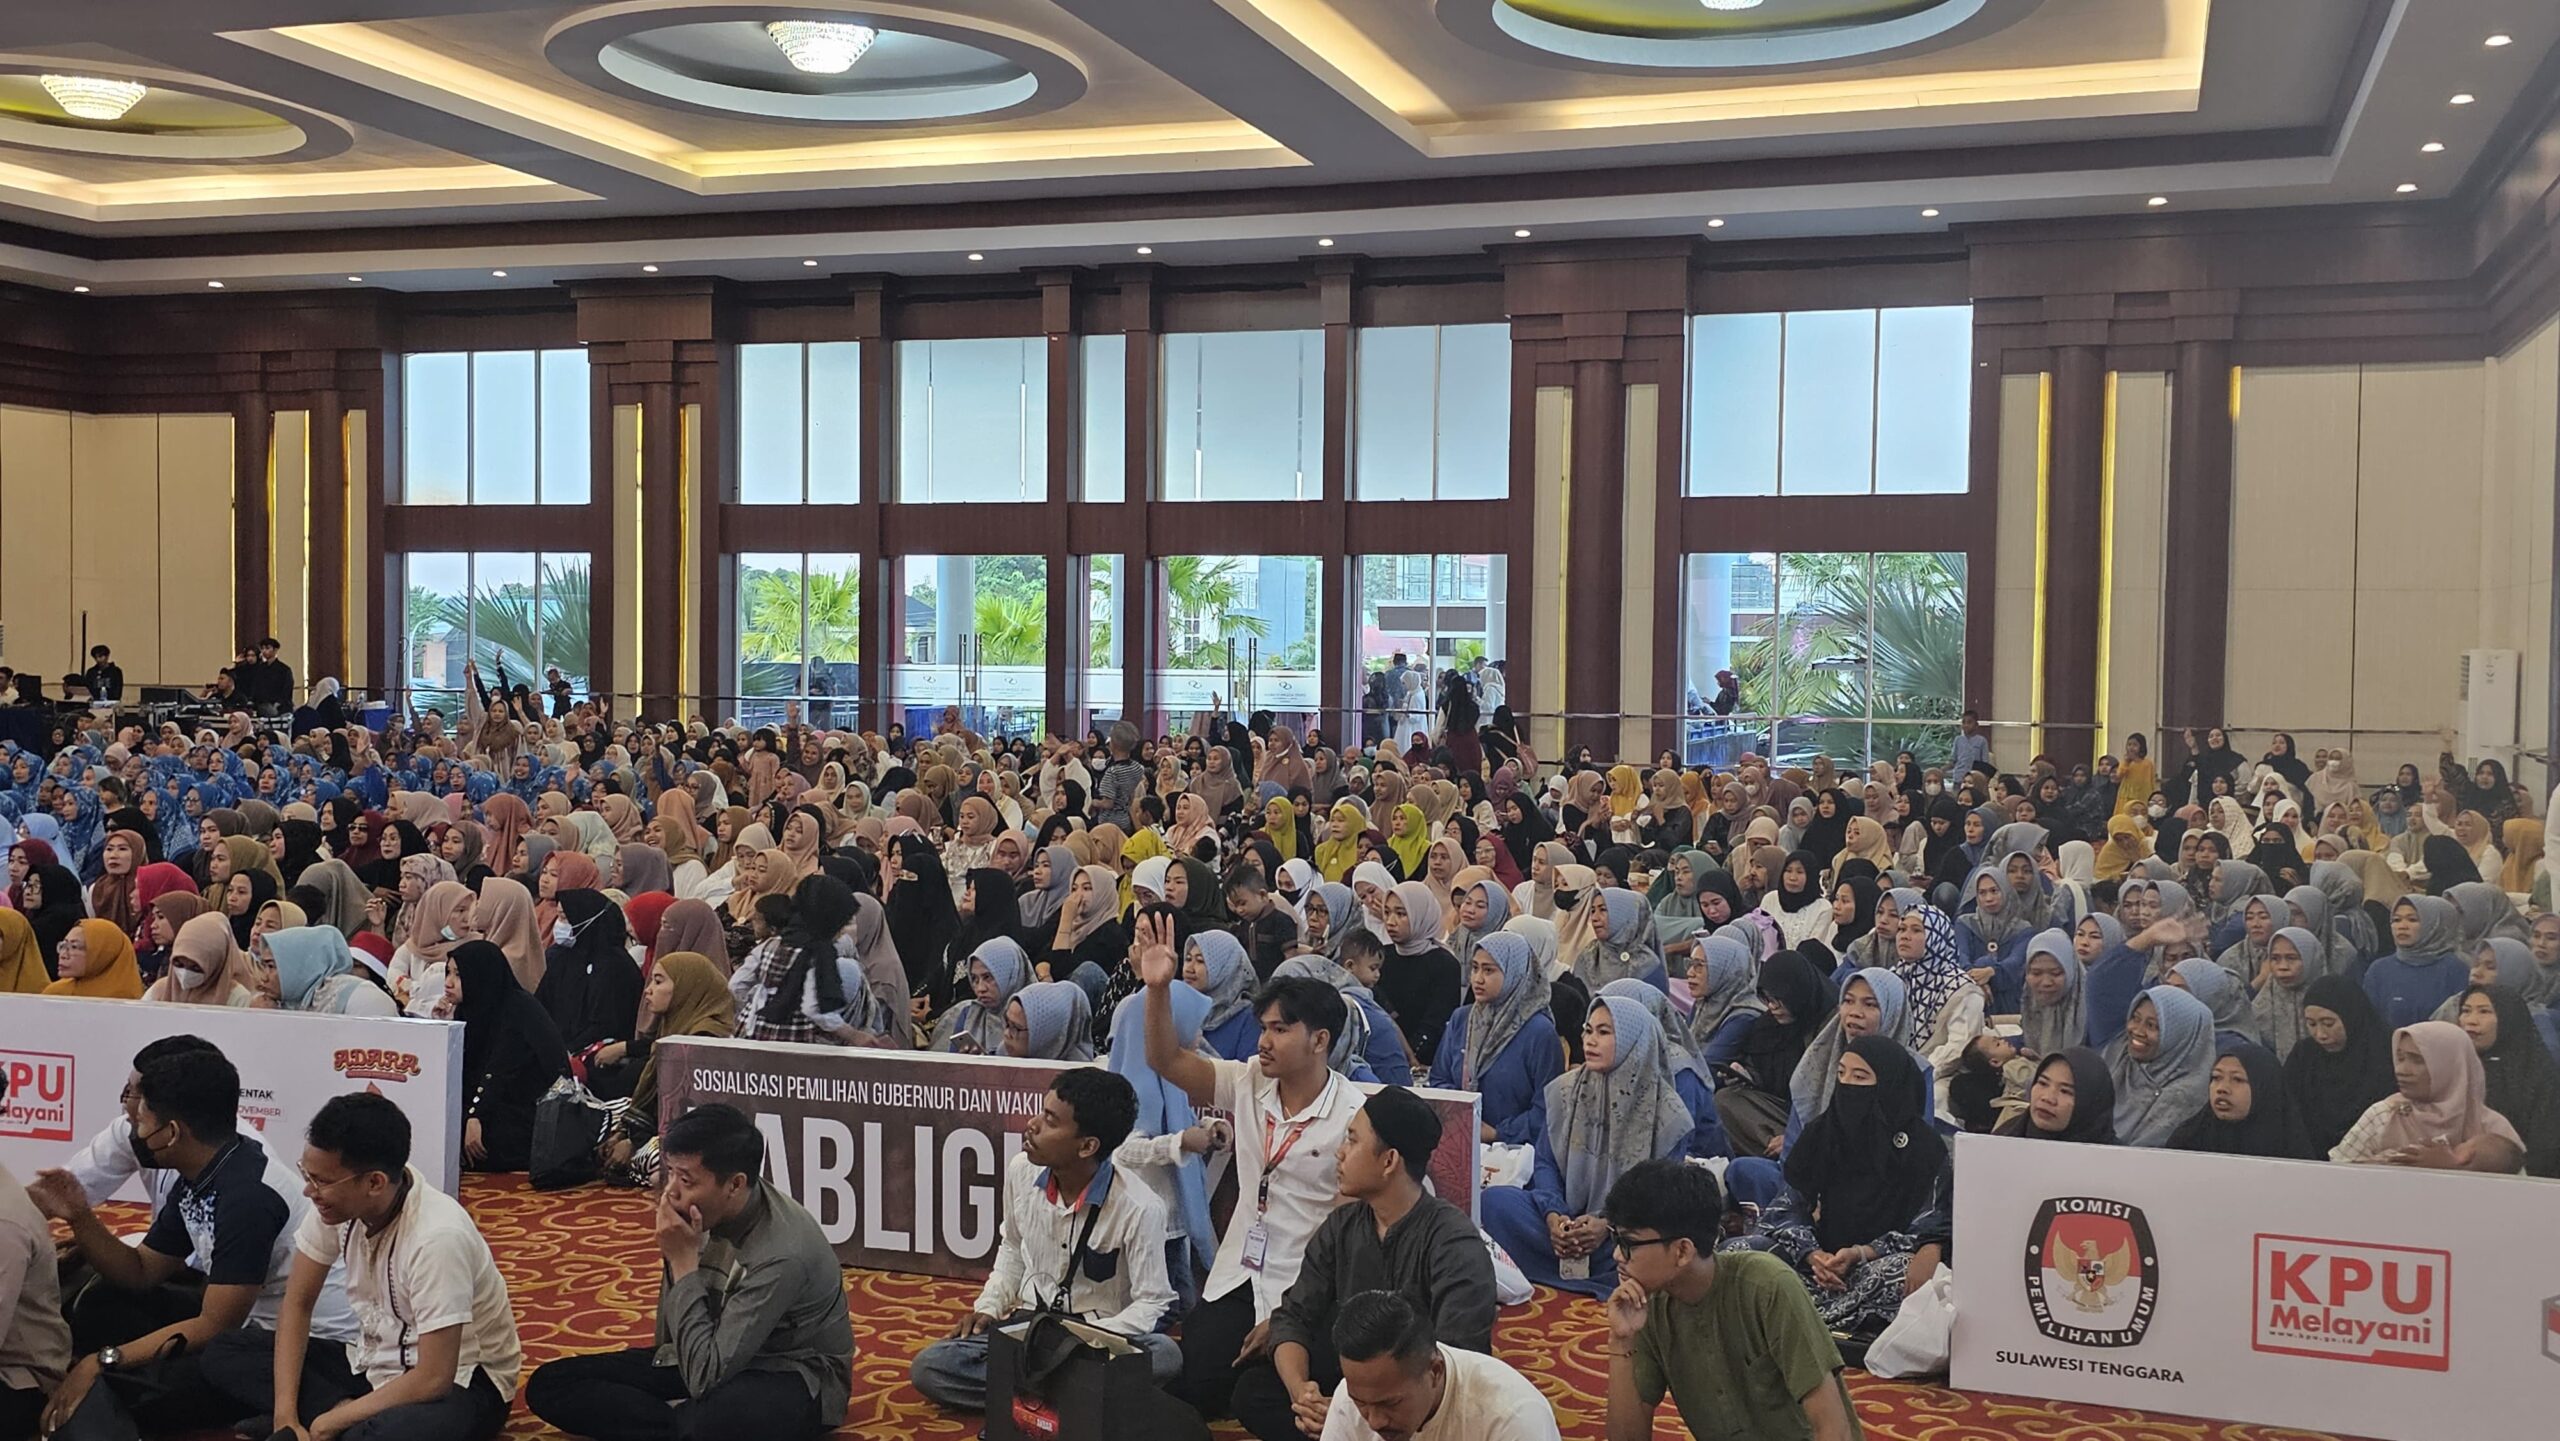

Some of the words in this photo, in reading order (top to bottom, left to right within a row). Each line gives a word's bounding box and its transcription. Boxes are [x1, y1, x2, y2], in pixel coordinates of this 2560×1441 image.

[0, 1061, 66, 1102] PU
[239, 1088, 273, 1100] ENTAK
[693, 1068, 783, 1098] SOSIALISASI
[787, 1075, 868, 1104] PEMILIHAN
[873, 1081, 955, 1110] GUBERNUR
[959, 1087, 991, 1113] DAN
[238, 1105, 281, 1117] OVEMBER
[687, 1106, 1023, 1260] ABLIG
[2055, 1199, 2131, 1219] KOMISI
[2270, 1250, 2433, 1315] KPU
[2028, 1275, 2113, 1344] PEMILIHAN
[2120, 1286, 2155, 1344] UMUM
[2269, 1304, 2432, 1344] Melayani
[1995, 1350, 2084, 1372] SULAWESI
[2088, 1360, 2185, 1384] TENGGARA
